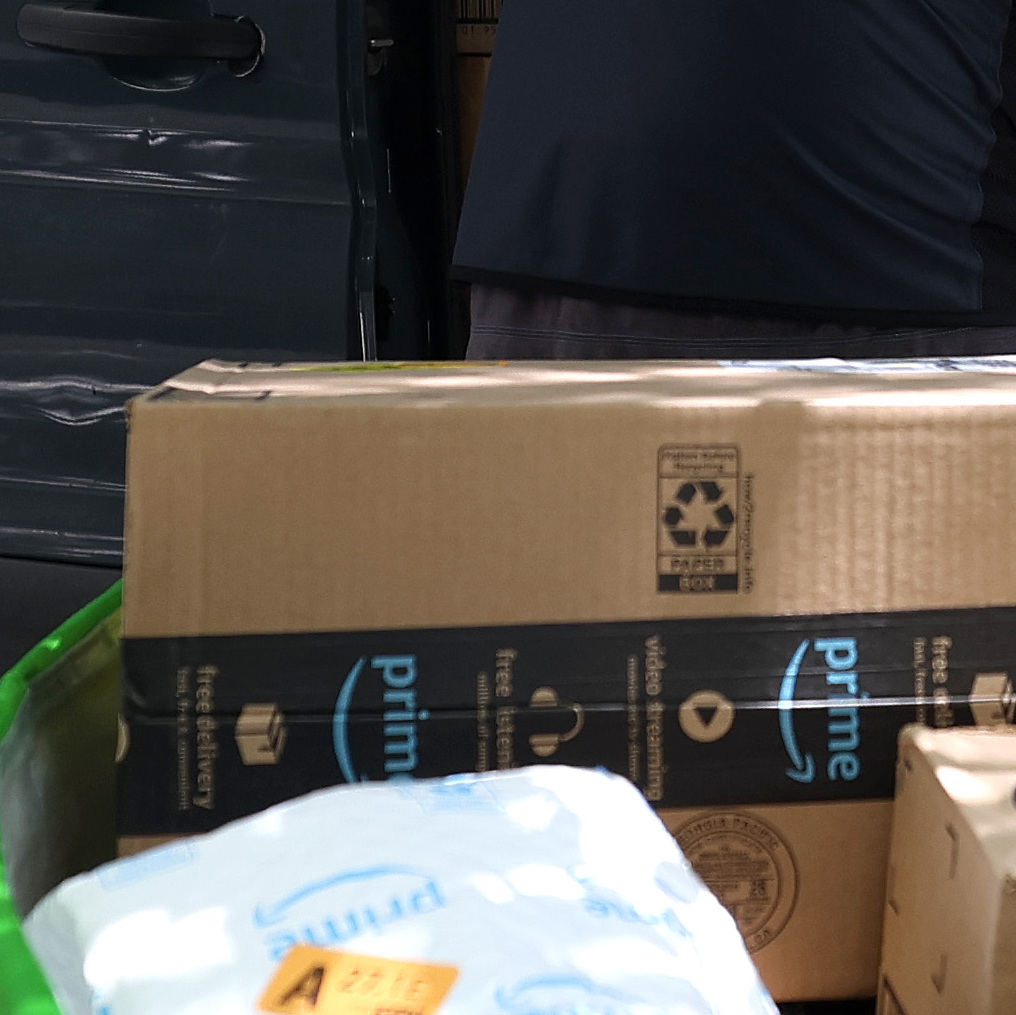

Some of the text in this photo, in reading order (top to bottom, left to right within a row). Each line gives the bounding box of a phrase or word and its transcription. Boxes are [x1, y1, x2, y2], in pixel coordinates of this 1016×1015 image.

[495, 648, 519, 697] free
[645, 634, 667, 696] video
[932, 635, 954, 684] free
[192, 665, 221, 810] free delivery
[813, 636, 870, 782] prime
